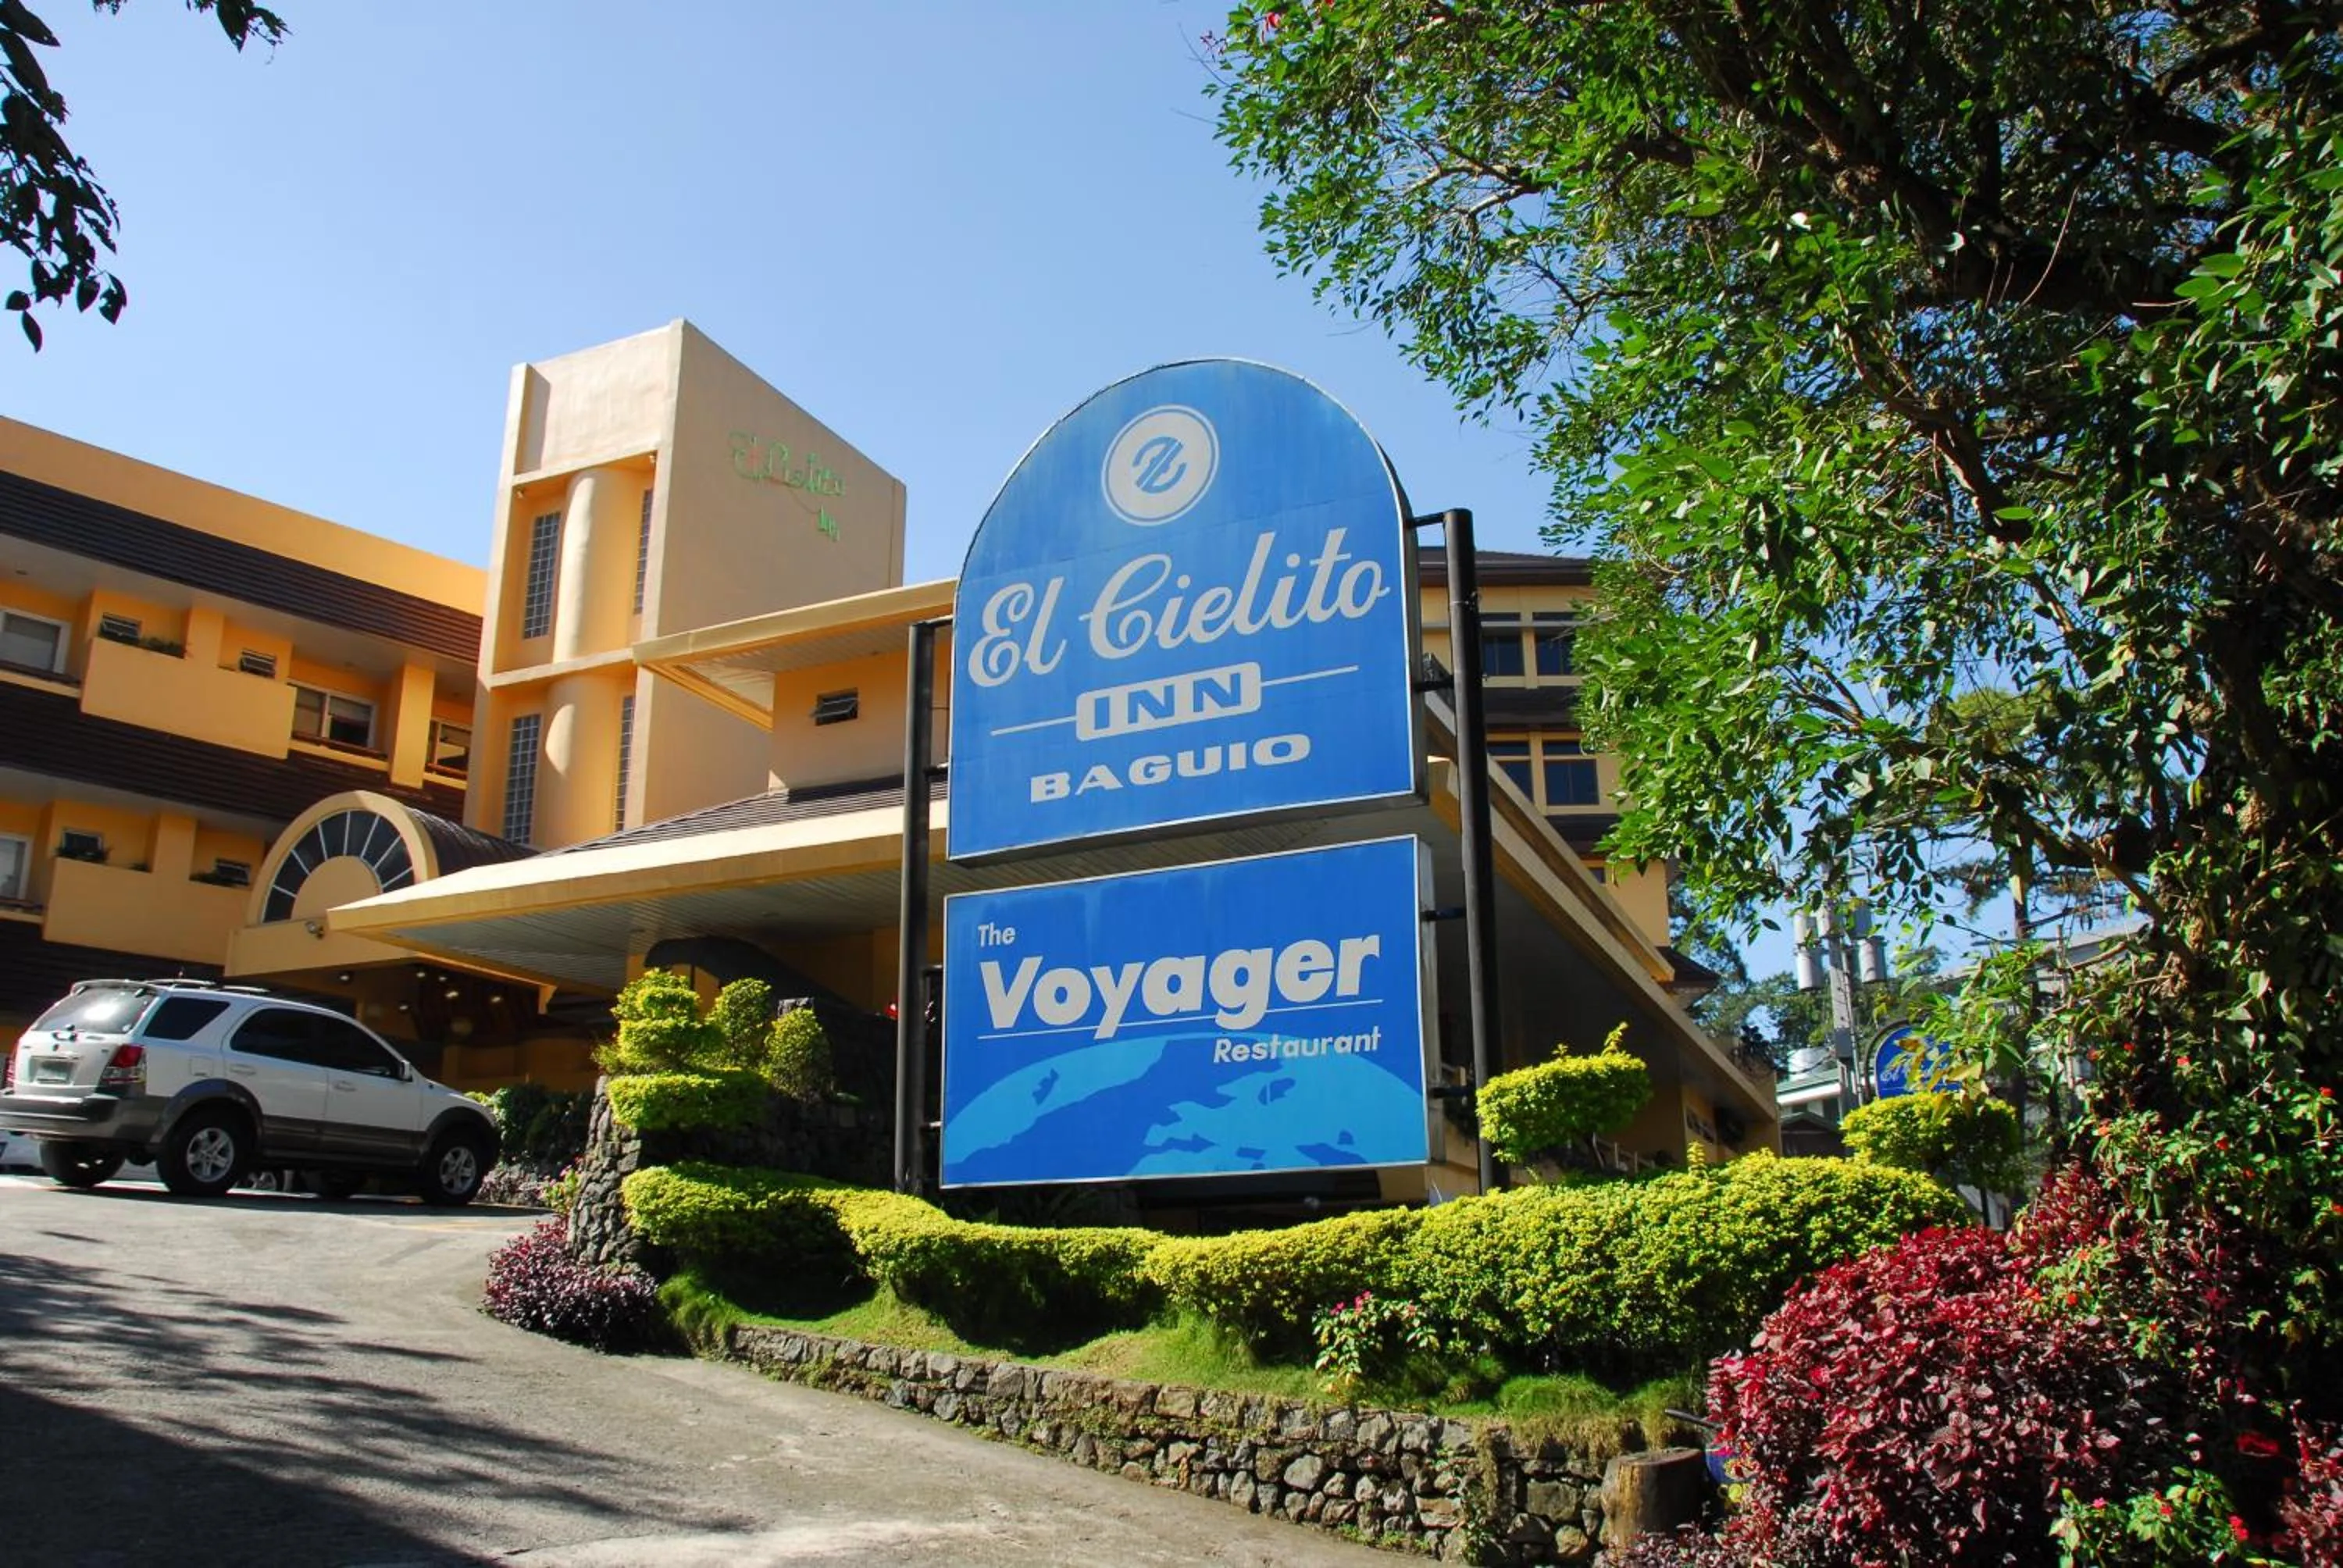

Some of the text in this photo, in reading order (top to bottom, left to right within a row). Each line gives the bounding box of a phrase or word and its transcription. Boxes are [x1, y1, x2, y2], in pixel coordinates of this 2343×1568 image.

[968, 527, 1390, 688] El Cielito
[1093, 670, 1242, 730] INN
[1030, 734, 1311, 804] BAGUIO
[977, 923, 1016, 948] The
[979, 934, 1381, 1039] Voyager
[1213, 1025, 1382, 1064] Restaurant
